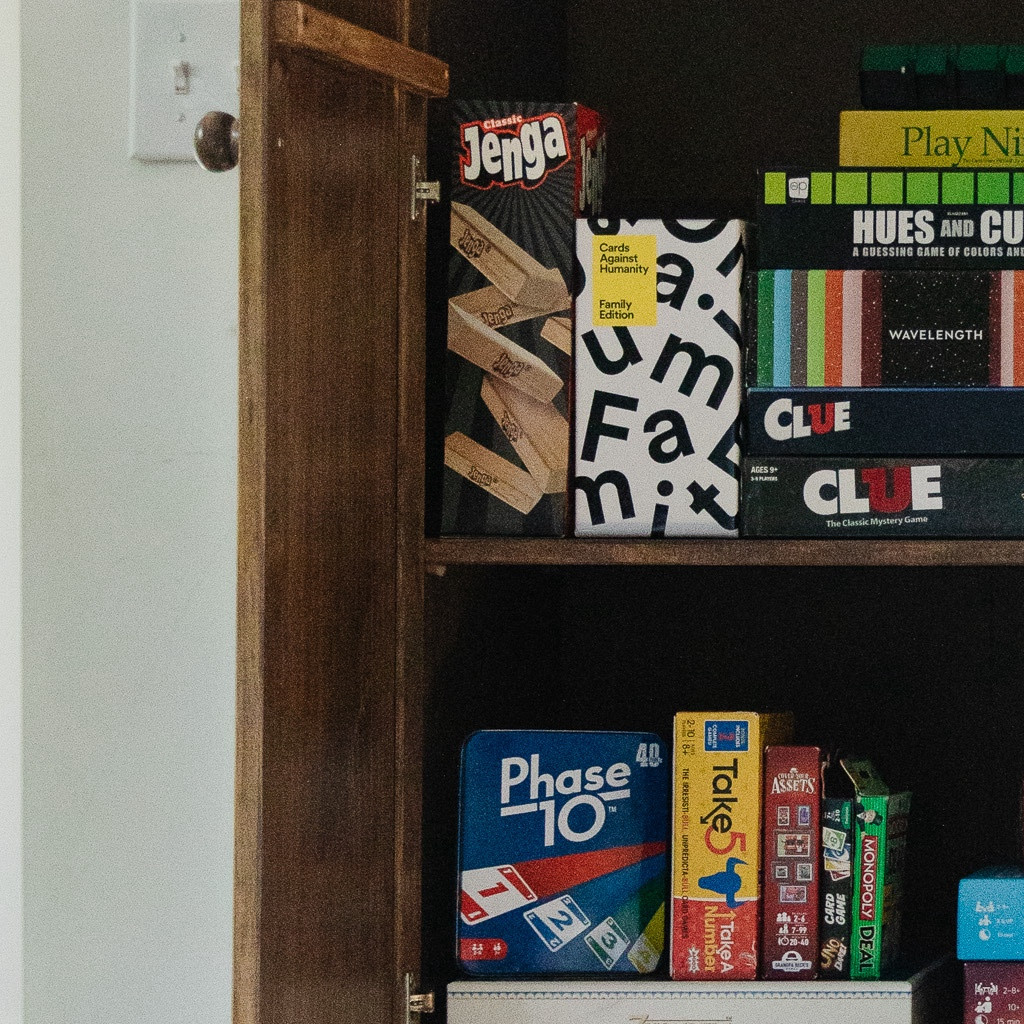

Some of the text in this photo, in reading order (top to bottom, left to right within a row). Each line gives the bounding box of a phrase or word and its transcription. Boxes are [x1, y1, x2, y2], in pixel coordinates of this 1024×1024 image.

[483, 114, 523, 130] Classic
[464, 117, 568, 181] Jenga
[902, 126, 972, 168] Play
[853, 210, 935, 244] HUES
[940, 219, 974, 237] AND
[599, 242, 630, 253] Cards
[599, 253, 638, 267] Against
[852, 247, 859, 257] A
[862, 247, 913, 257] GUESSING
[917, 247, 945, 257] GAME
[949, 247, 960, 257] OF
[964, 247, 1003, 257] COLORS
[599, 263, 649, 276] Humanity
[599, 299, 632, 311] Family
[599, 310, 634, 320] Edition
[889, 329, 983, 341] WAVELENGTH
[764, 398, 850, 441] CLUE
[803, 465, 943, 515] CLUE
[826, 514, 928, 528] The Classic Mystery Game
[500, 753, 632, 804] Phase
[682, 768, 690, 780] THE
[771, 777, 816, 794] ASSETS
[537, 794, 606, 847] 10
[700, 758, 747, 855] Take 5
[824, 893, 835, 925] CARD
[835, 893, 846, 925] GAME
[859, 839, 876, 972] MONOPOLY DEAL
[703, 905, 717, 972] Number
[716, 921, 735, 973] Take A
[790, 938, 809, 946] 20-40
[820, 939, 841, 969] UNO
[1008, 1003, 1020, 1011] 10+
